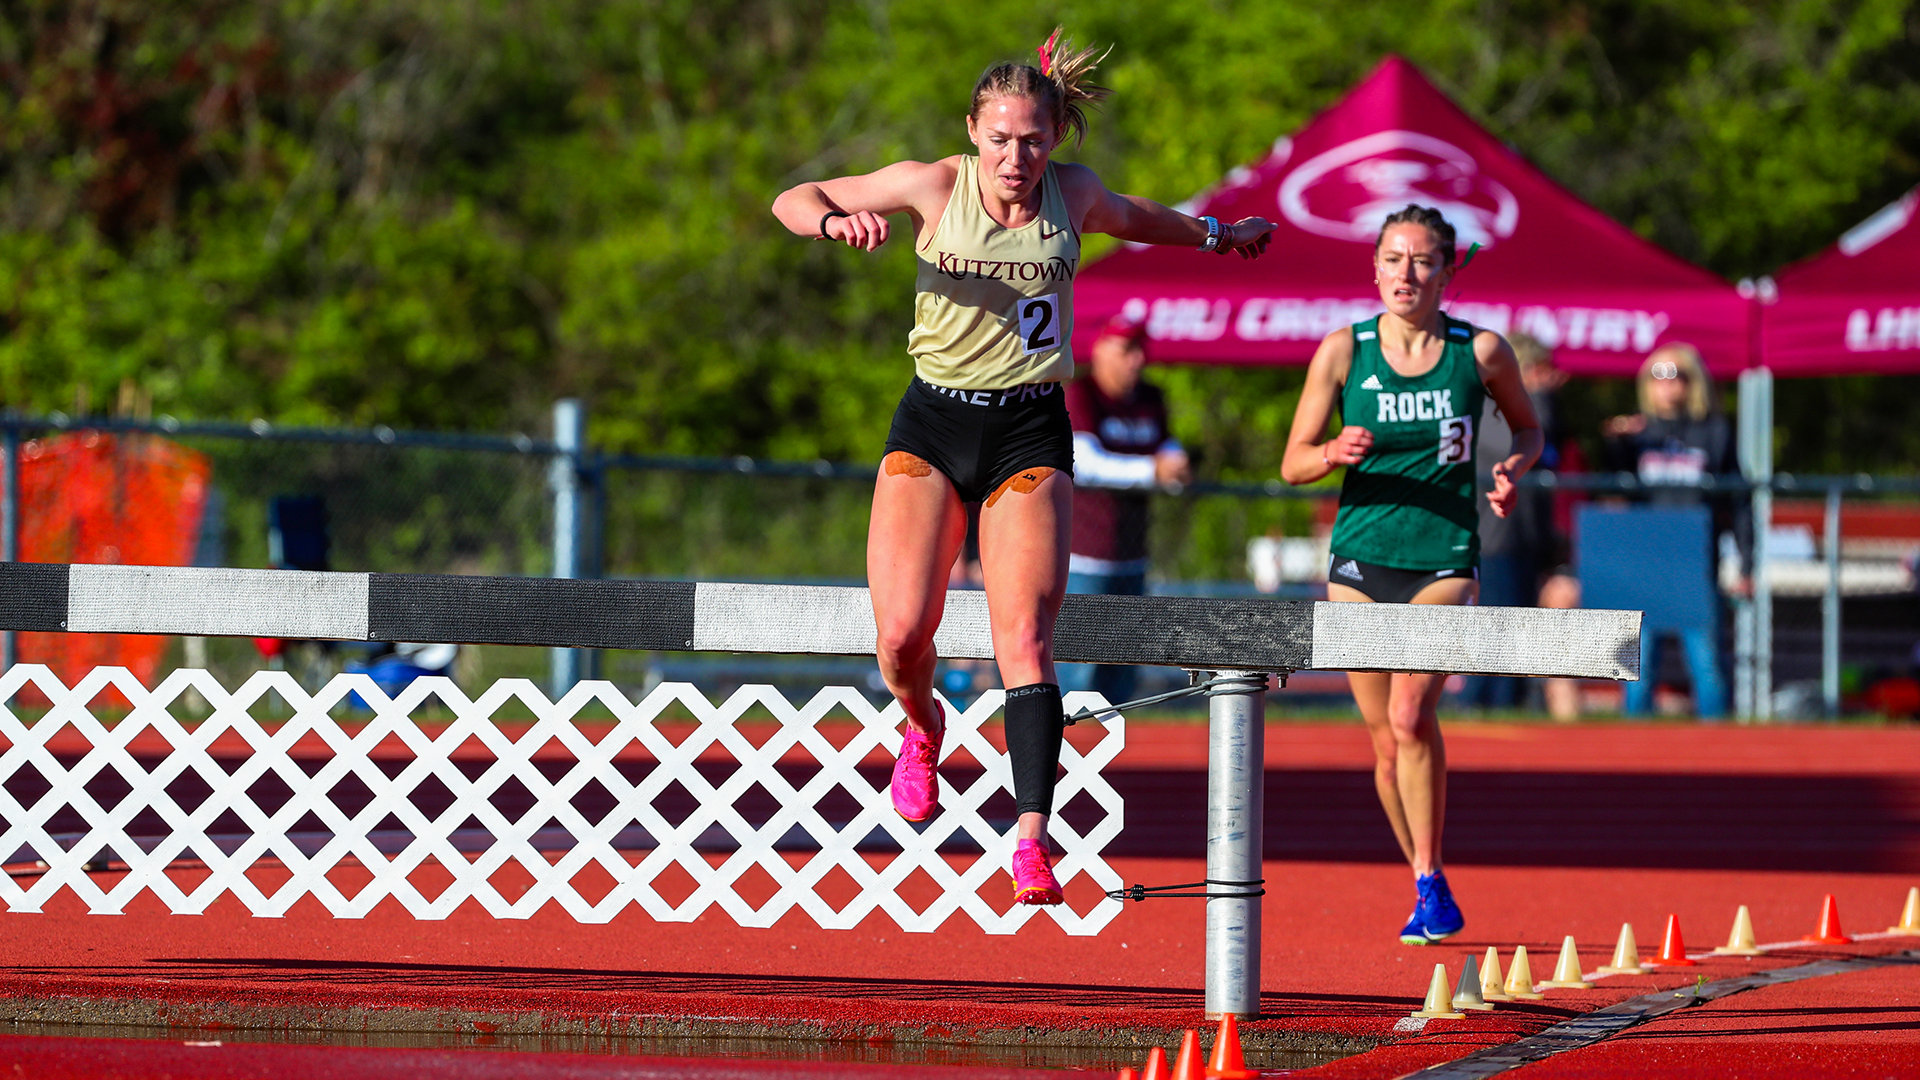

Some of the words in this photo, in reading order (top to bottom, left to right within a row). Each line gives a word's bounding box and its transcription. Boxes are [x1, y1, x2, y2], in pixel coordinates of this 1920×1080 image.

[937, 251, 1077, 282] KUTZTOWN
[1023, 300, 1055, 351] 2
[1440, 301, 1670, 353] UNTRY
[1844, 307, 1920, 352] LH
[922, 380, 992, 407] KE
[1376, 388, 1454, 423] ROCK
[1446, 421, 1466, 462] 3
